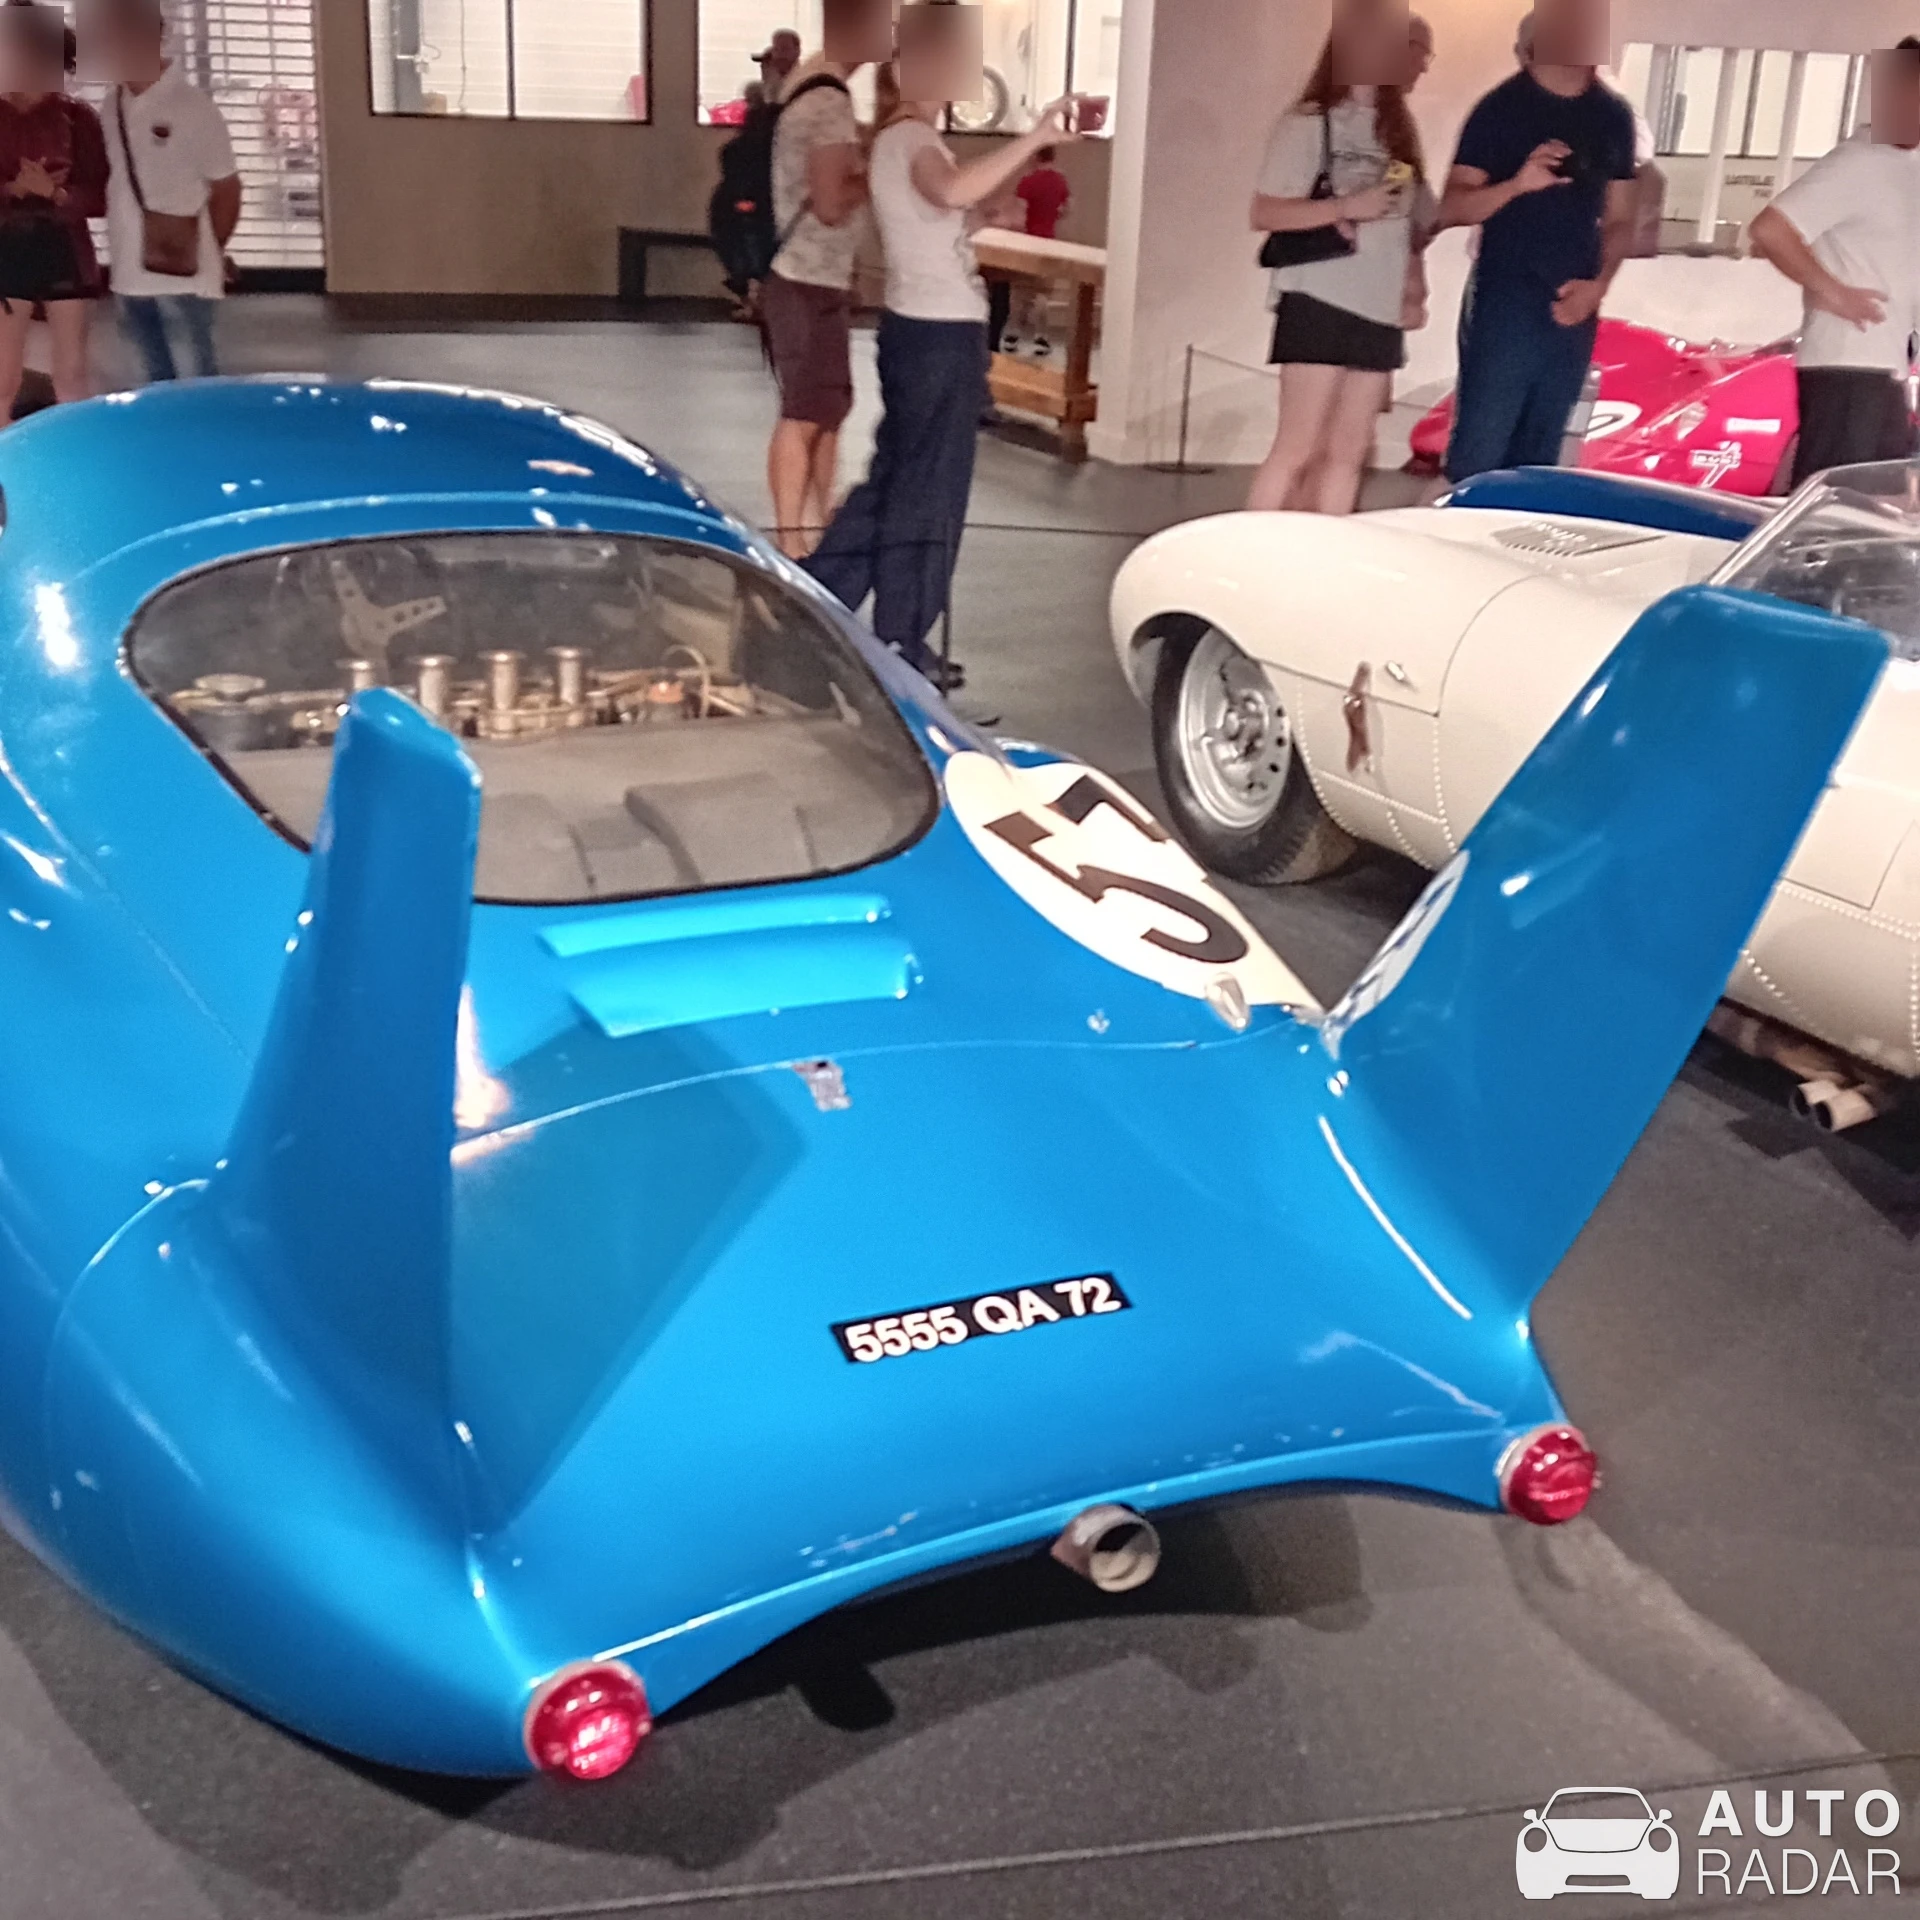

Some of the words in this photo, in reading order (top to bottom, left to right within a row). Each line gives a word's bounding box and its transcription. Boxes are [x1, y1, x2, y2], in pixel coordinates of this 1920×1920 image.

[844, 1305, 969, 1363] 5555
[972, 1288, 1061, 1333] QA
[1053, 1276, 1122, 1317] 72
